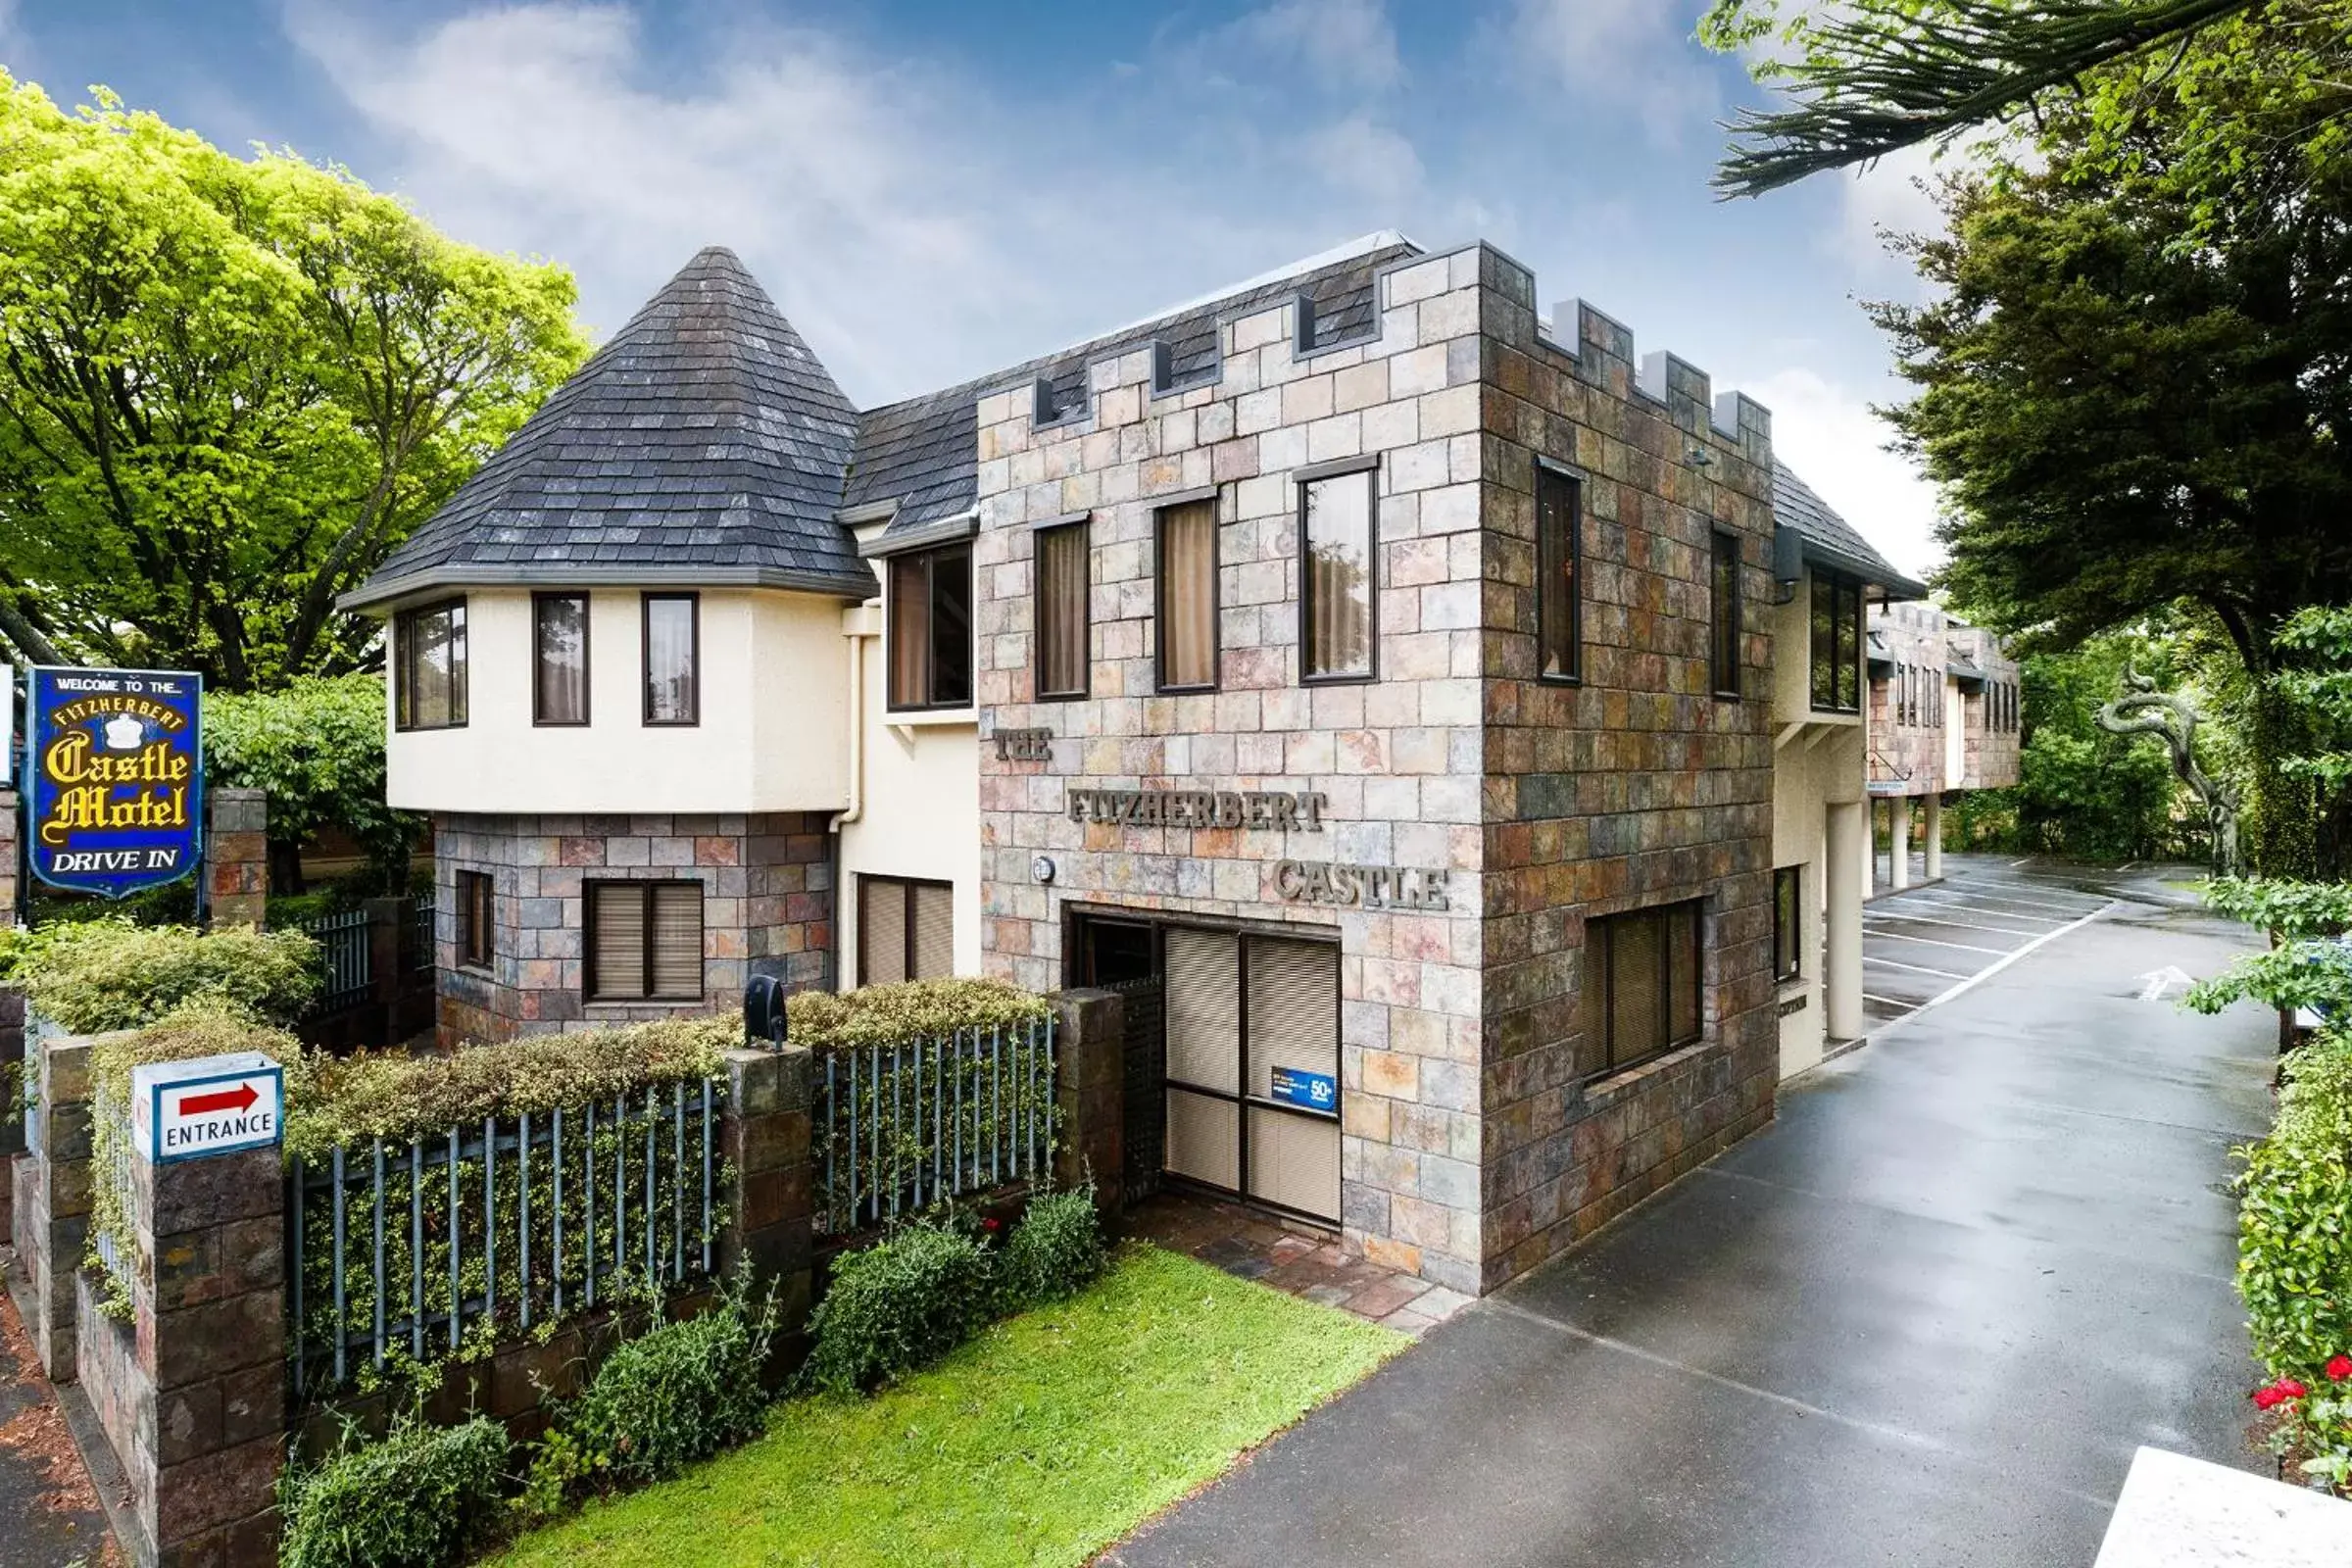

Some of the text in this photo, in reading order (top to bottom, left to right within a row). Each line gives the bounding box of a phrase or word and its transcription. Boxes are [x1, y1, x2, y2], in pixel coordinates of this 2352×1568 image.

[57, 678, 119, 692] WELCOME
[124, 680, 143, 693] TO
[54, 697, 183, 729] FITZHERBERT
[46, 730, 188, 784] Castle
[993, 728, 1053, 761] THE
[41, 786, 186, 844] Motel
[1067, 788, 1328, 833] FITZHERBERT
[52, 849, 179, 872] DRIVE IN
[1271, 858, 1449, 911] CASTLE
[167, 1112, 272, 1147] ENTRANCE
